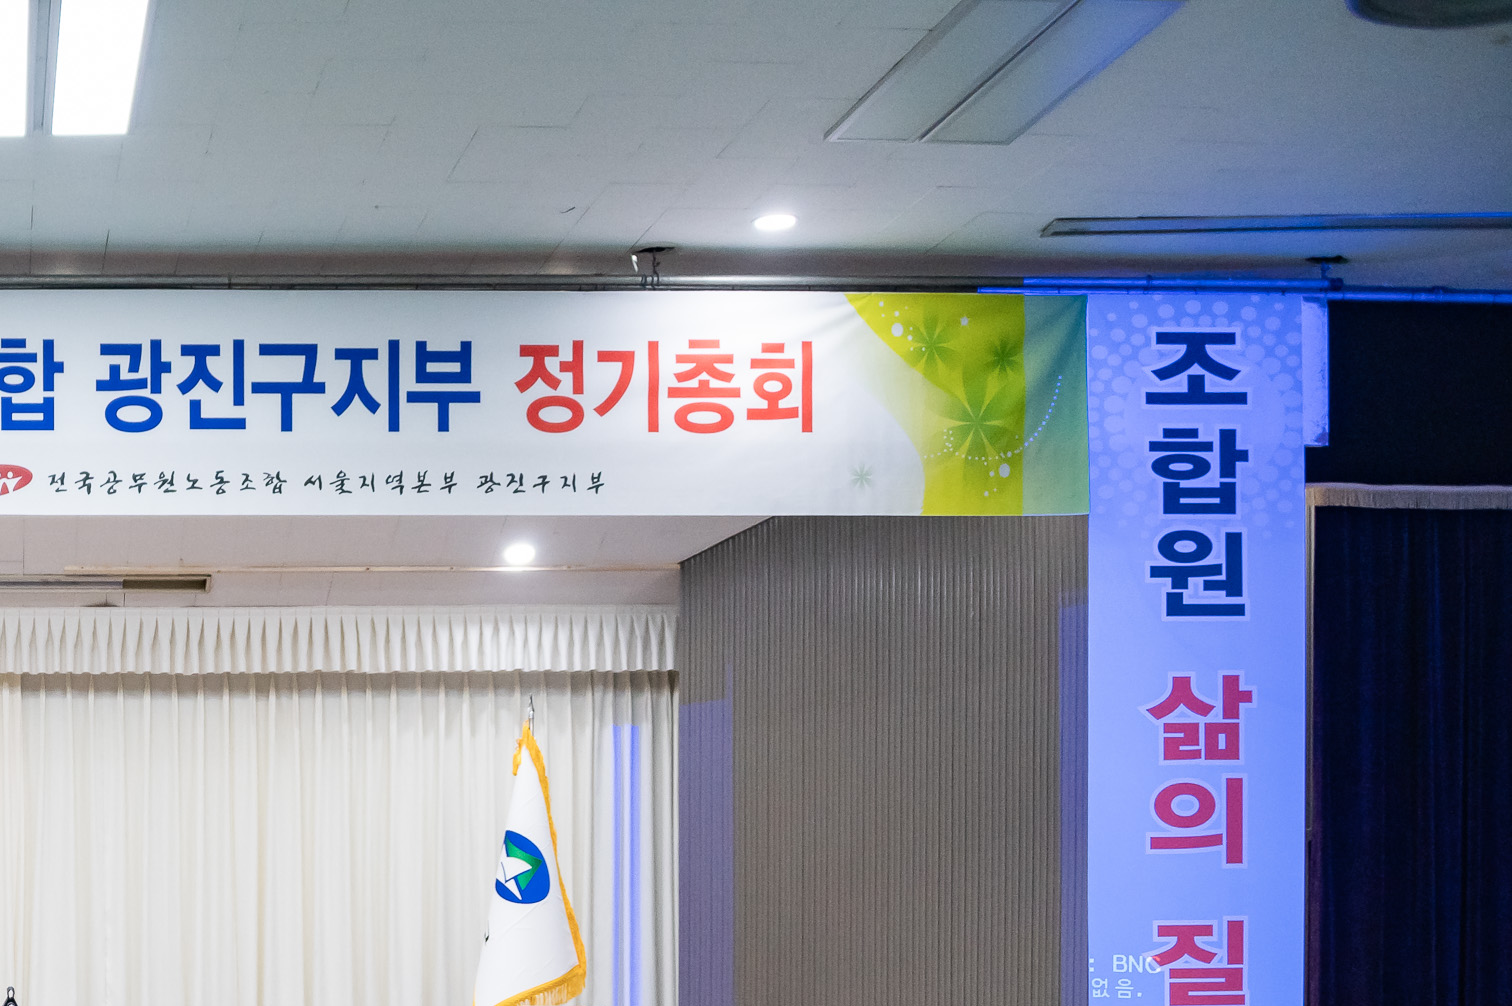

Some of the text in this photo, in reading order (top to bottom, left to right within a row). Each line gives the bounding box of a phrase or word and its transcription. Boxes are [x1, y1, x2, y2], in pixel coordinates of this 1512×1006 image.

[94, 338, 482, 434] 광진구지부
[513, 338, 816, 435] 정기총회
[48, 469, 605, 495] 전국공무원노동조합 서울지역본부 광진구지부
[1144, 331, 1250, 617] 조합원
[1145, 674, 1253, 866] 삶의
[1152, 917, 1246, 1006] 질
